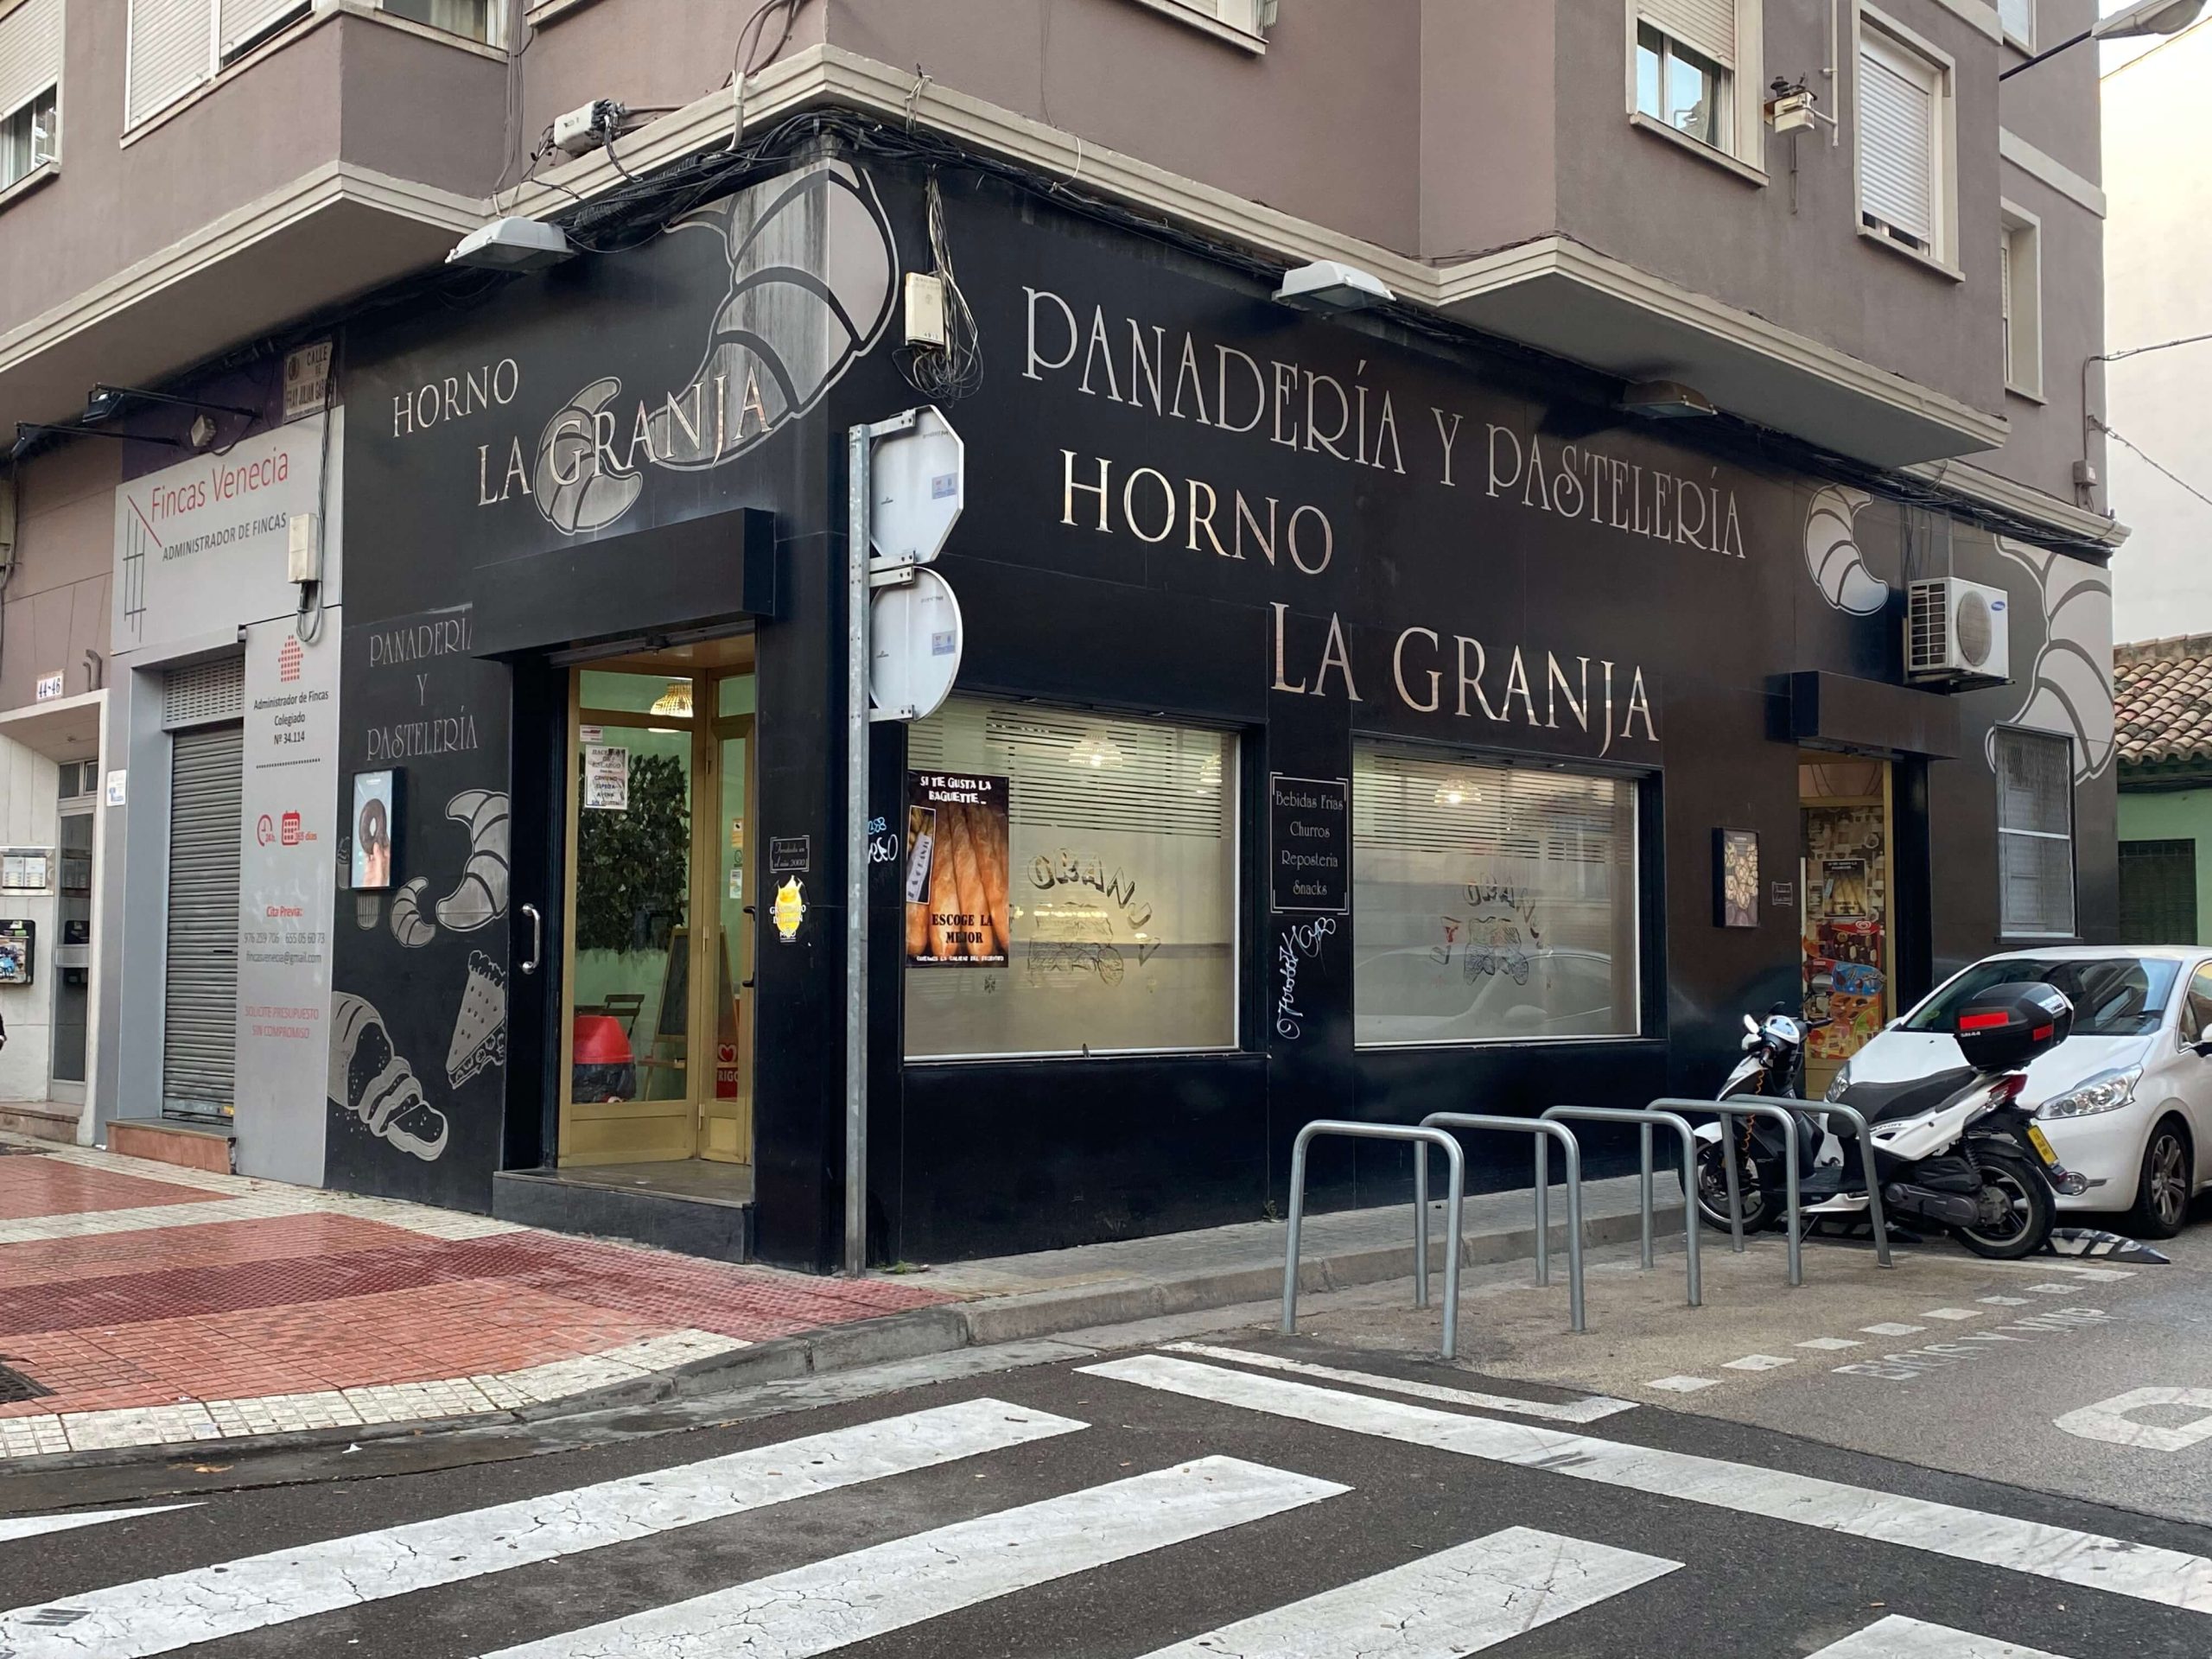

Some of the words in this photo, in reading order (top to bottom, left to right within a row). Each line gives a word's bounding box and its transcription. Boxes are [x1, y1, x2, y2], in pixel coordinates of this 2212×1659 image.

[307, 346, 328, 366] CALLE
[392, 358, 518, 438] HORNO
[1020, 284, 1407, 476] PANADERÍA
[1430, 407, 1464, 488] Y
[1484, 422, 1746, 560] PASTELERÍA
[477, 435, 533, 507] LA
[548, 365, 774, 486] GRANJA
[152, 485, 206, 523] Fincas
[213, 446, 289, 502] Venecia
[1058, 448, 1333, 575] HORNO
[162, 527, 236, 562] ADMINISTRADOR
[238, 523, 251, 540] DE
[252, 512, 287, 537] FINCAS
[1269, 601, 1363, 702] LA
[1393, 626, 1661, 758] GRANJA
[416, 673, 429, 707] Y
[254, 694, 298, 710] Administrador
[298, 692, 308, 703] de
[308, 690, 329, 702] Fincas
[274, 711, 306, 727] Colegiado
[283, 730, 305, 744] 34.114
[366, 706, 479, 762] PASTELERÍA
[920, 776, 929, 786] SI
[931, 777, 945, 788] TE
[947, 777, 976, 790] GUSTA
[978, 780, 992, 791] LA
[1275, 790, 1318, 809] Bebidas
[1289, 821, 1331, 838] Churros
[1281, 849, 1338, 871] Reposteria
[1293, 880, 1328, 896] Snacks
[266, 906, 279, 918] Cita
[931, 913, 975, 926] ESCOGE
[980, 914, 993, 926] LA
[244, 932, 255, 944] 976
[285, 932, 297, 944] 655
[317, 932, 325, 944] 73
[945, 931, 983, 944] MEJOR
[245, 1005, 272, 1018] SOLICITE
[273, 1006, 319, 1020] PRESUPUESTO
[252, 1025, 263, 1037] SIN
[264, 1026, 310, 1039] COMPROMISO
